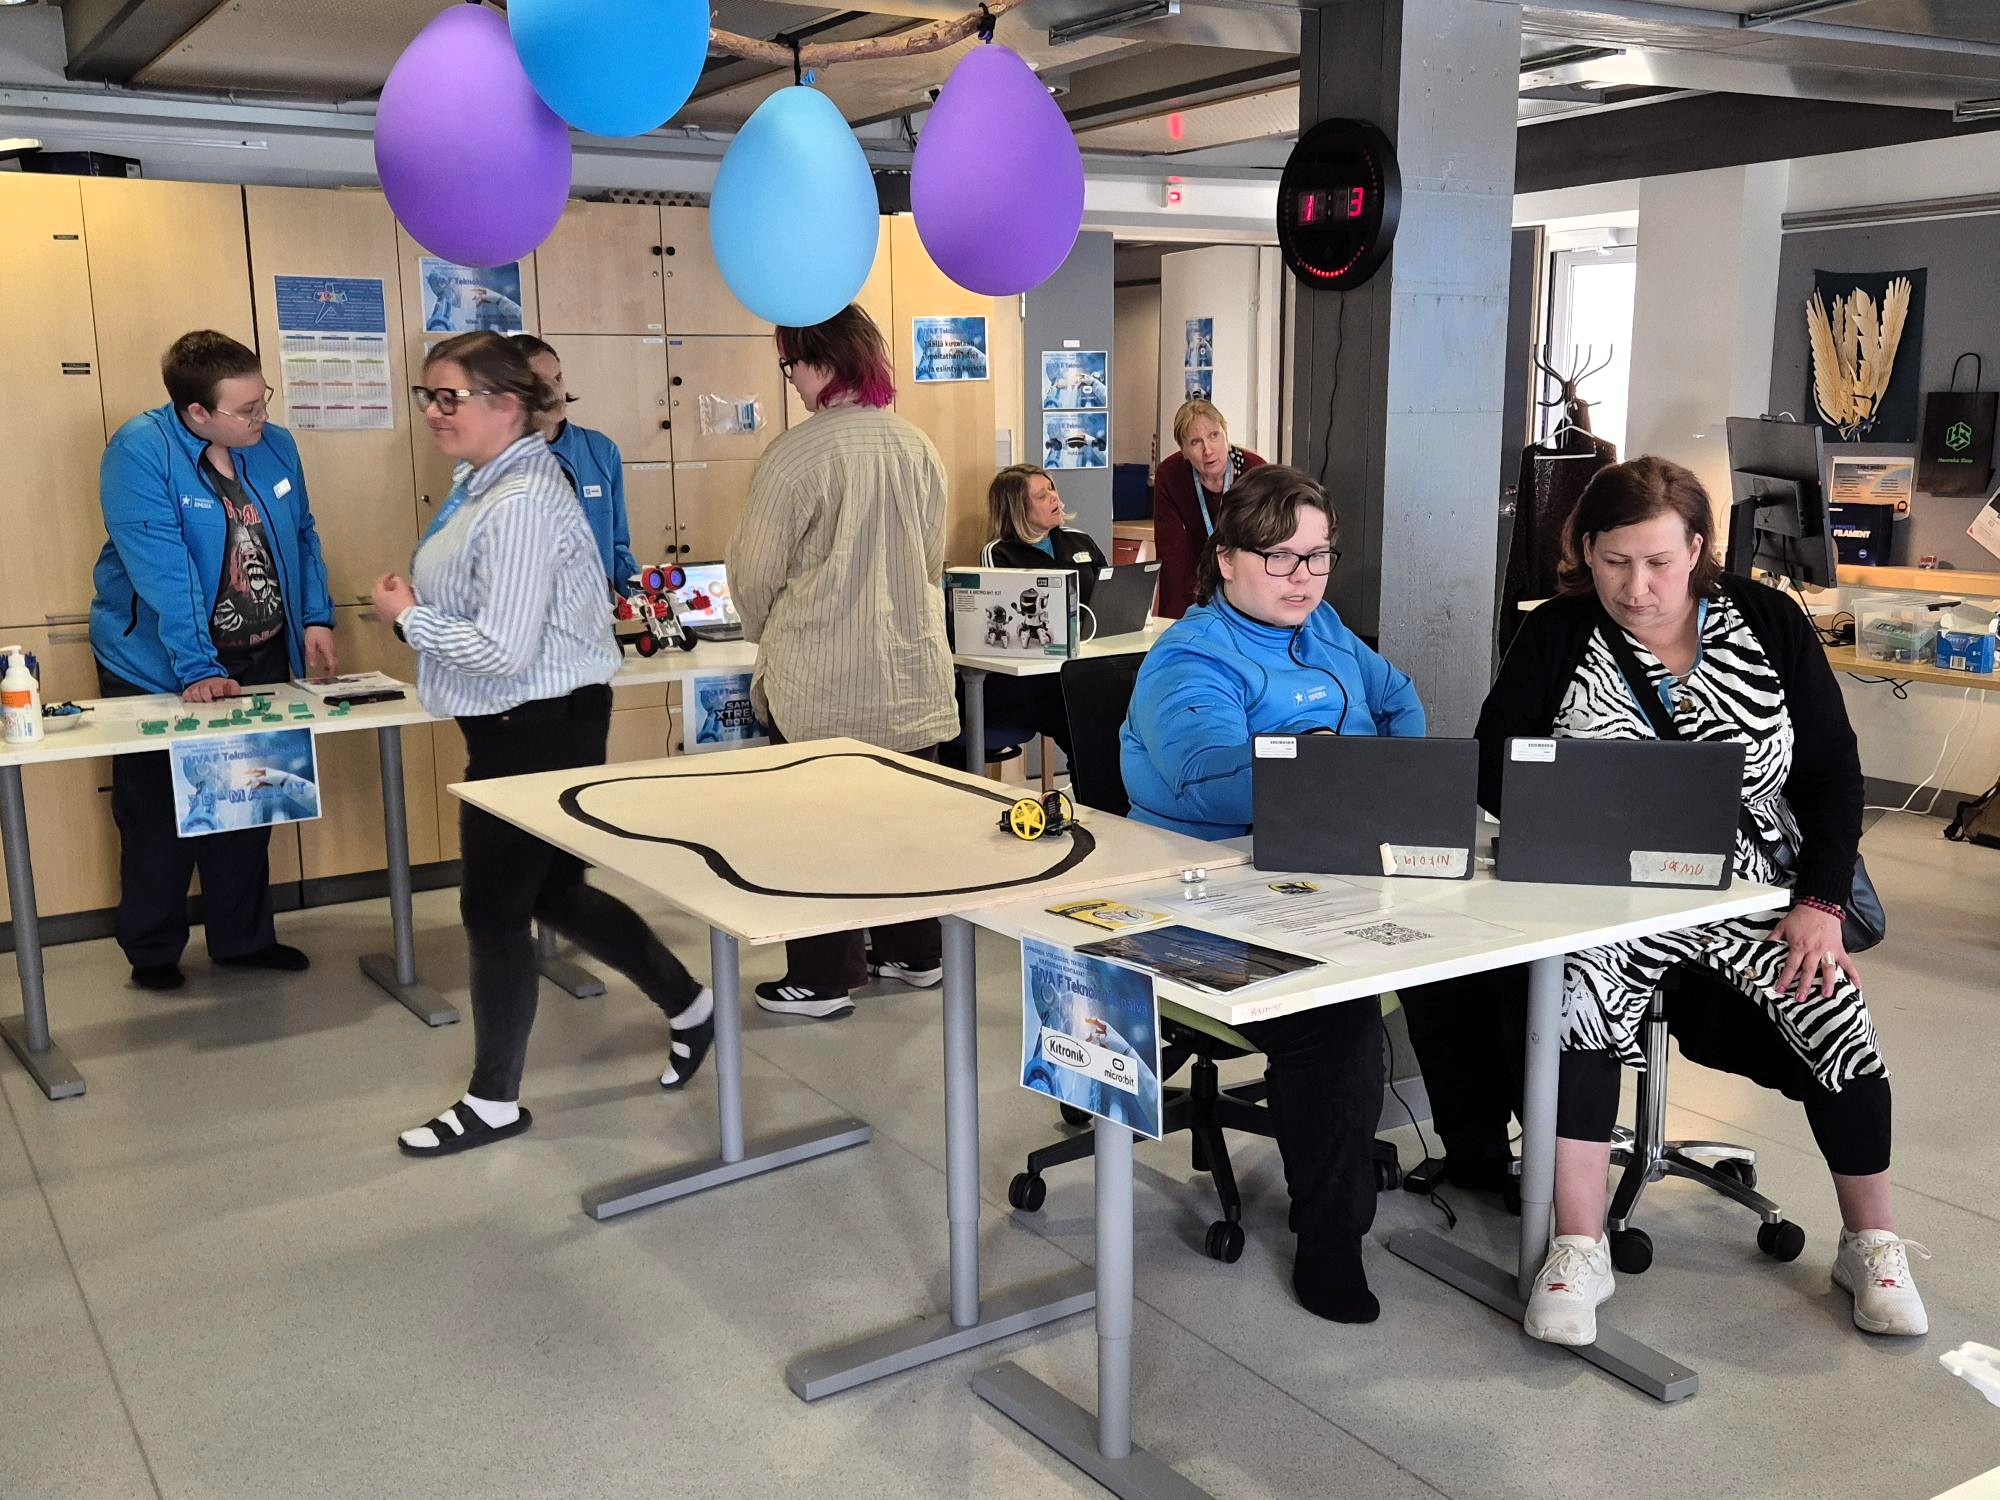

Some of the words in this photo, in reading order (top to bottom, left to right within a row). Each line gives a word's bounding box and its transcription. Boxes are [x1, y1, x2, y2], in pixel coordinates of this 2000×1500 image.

[1833, 529, 1871, 538] FILAMENT
[716, 708, 754, 720] XTRE
[725, 716, 754, 727] BOTS
[1049, 1039, 1085, 1064] Kitronik
[1104, 1068, 1135, 1087] micro:bit
